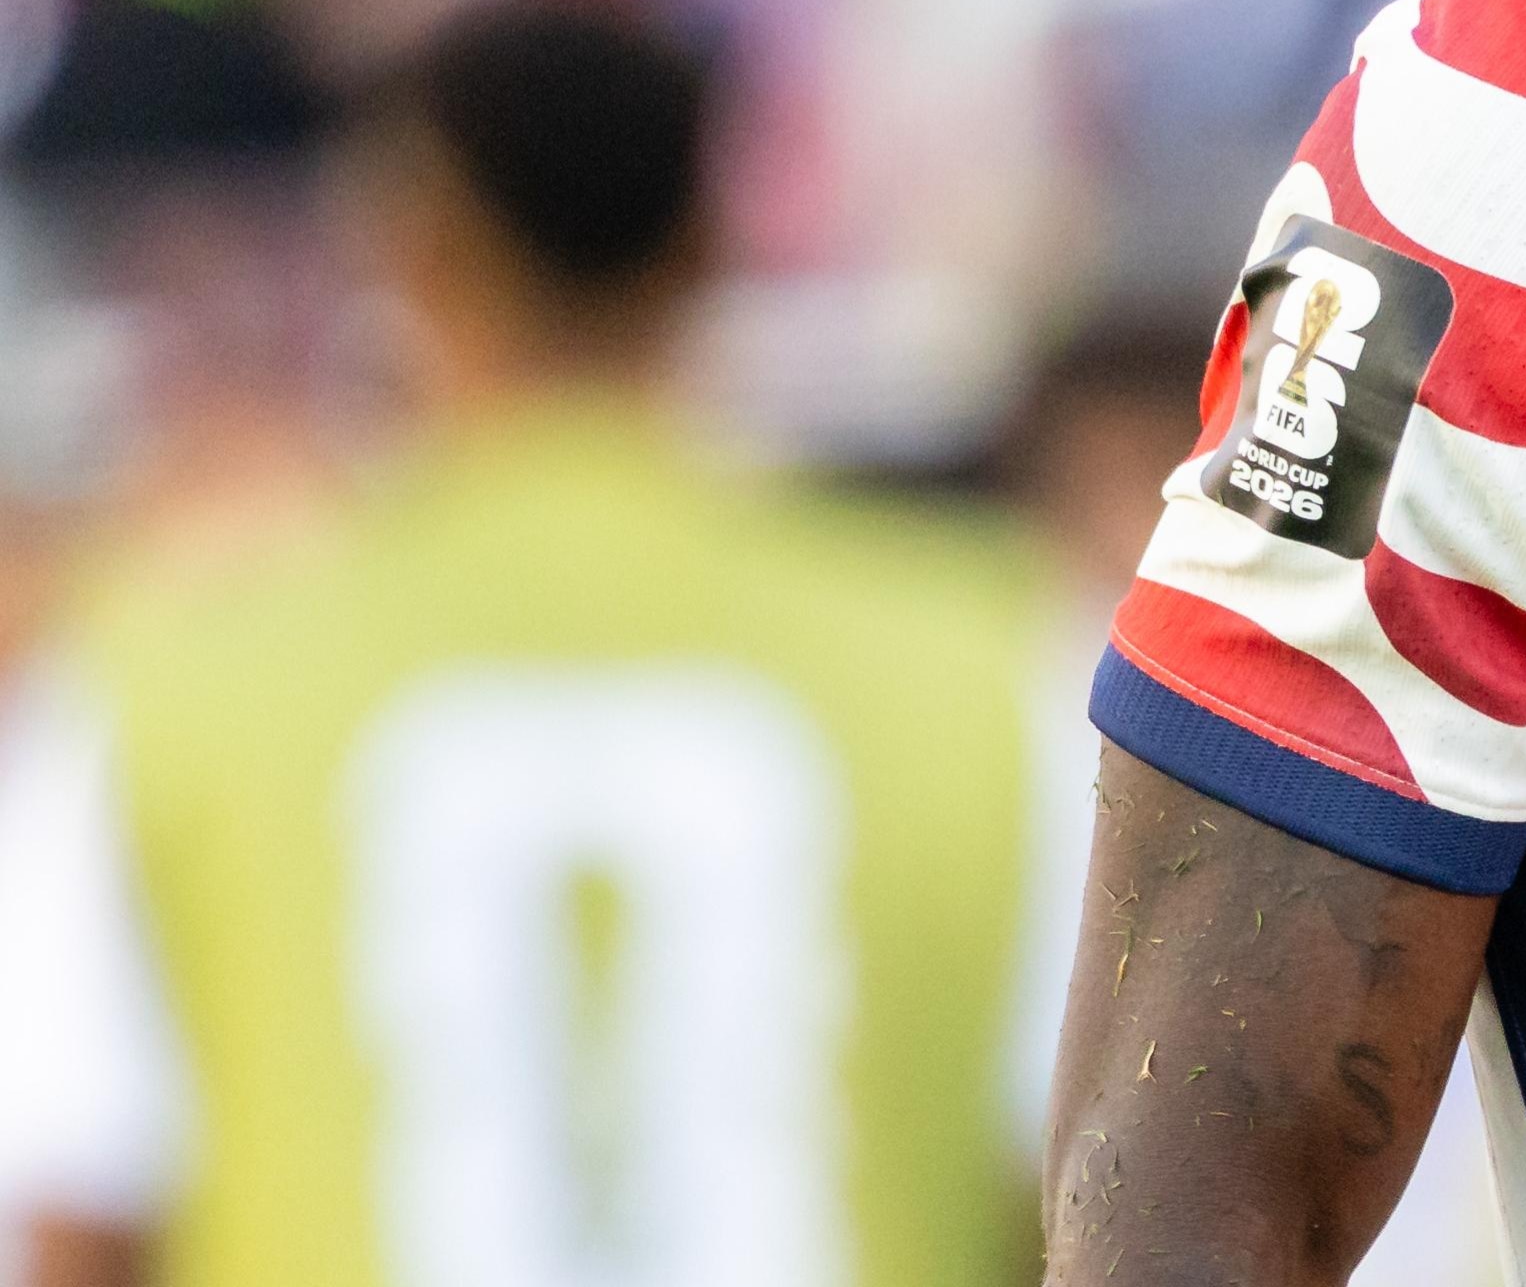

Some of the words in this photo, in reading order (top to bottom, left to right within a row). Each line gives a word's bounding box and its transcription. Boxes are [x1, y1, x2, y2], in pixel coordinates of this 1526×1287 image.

[1267, 404, 1305, 437] FIFA
[1229, 459, 1324, 521] 2026
[1237, 437, 1289, 476] WORLD
[1288, 463, 1329, 490] CUP
